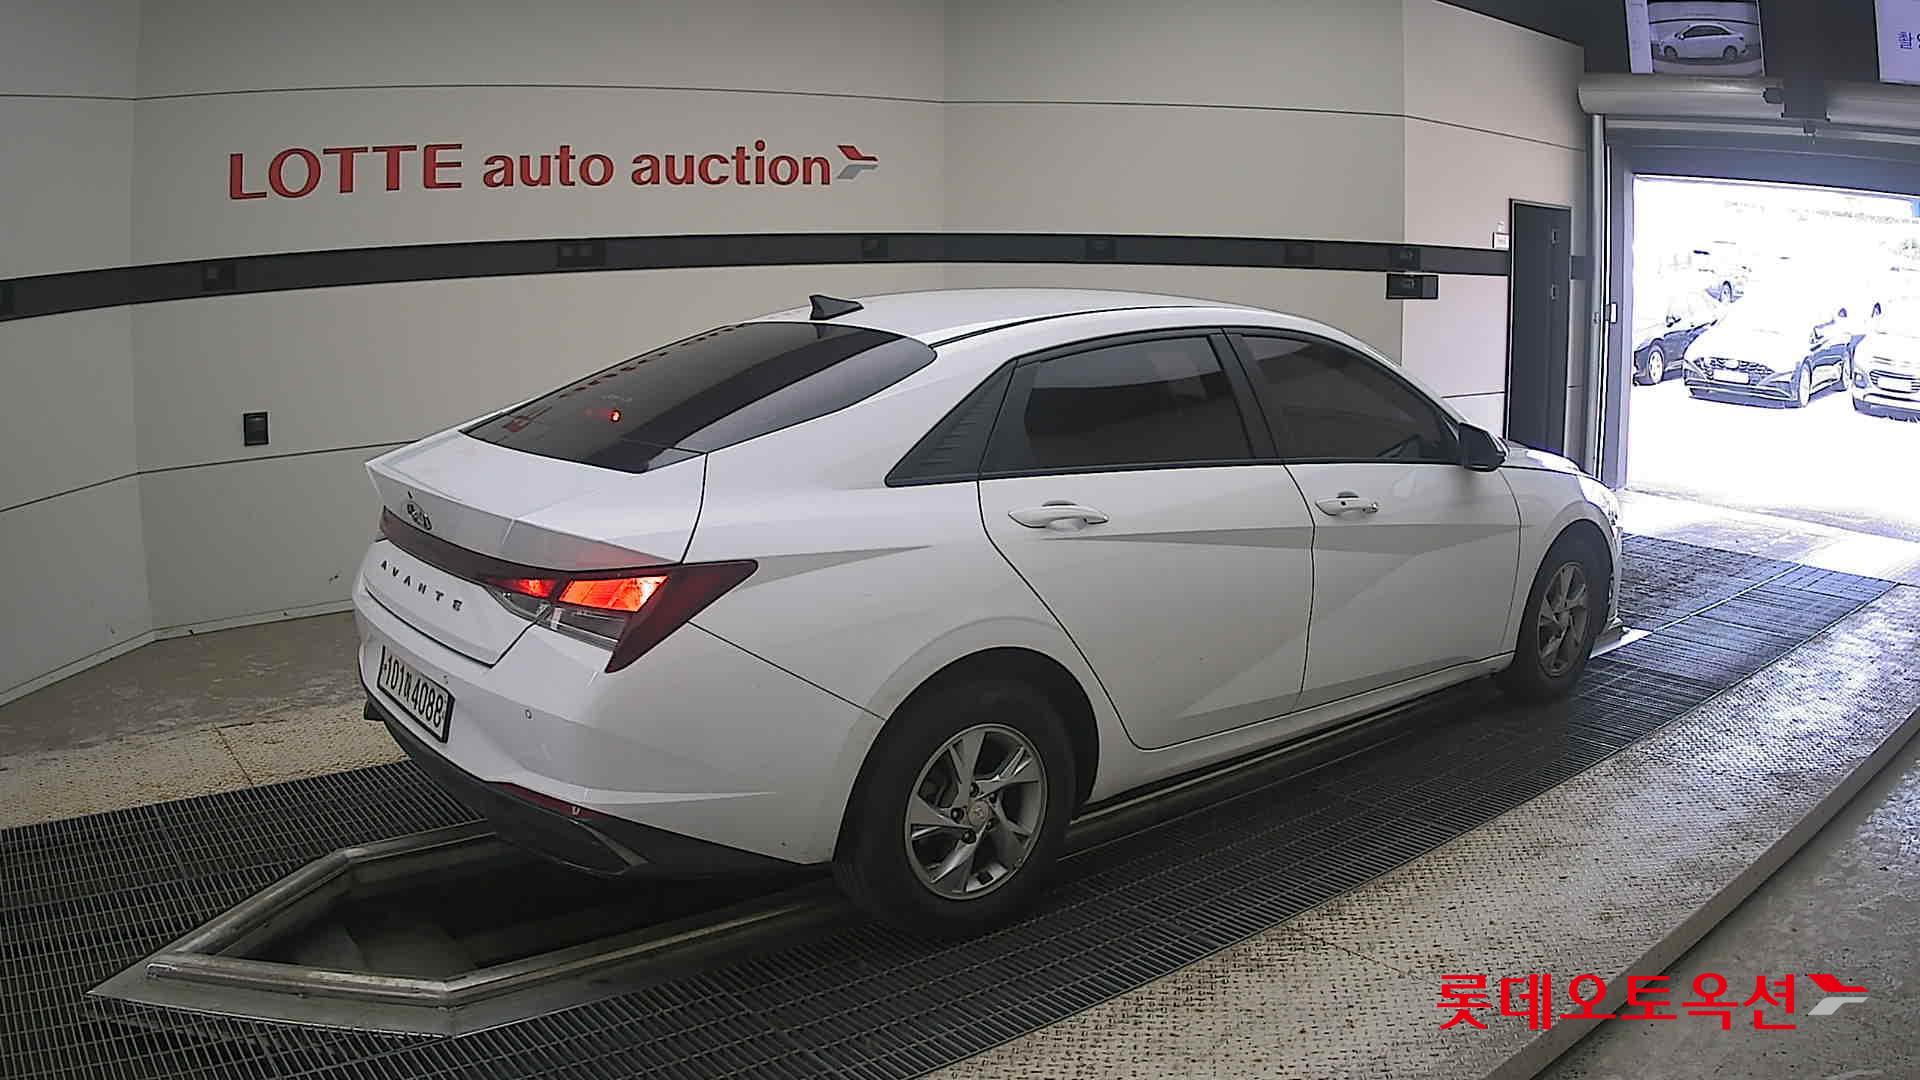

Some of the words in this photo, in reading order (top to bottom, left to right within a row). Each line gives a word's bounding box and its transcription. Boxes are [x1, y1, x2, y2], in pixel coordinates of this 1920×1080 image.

[228, 143, 463, 199] LOTTE
[482, 144, 615, 187] auto
[631, 139, 832, 186] auction
[380, 559, 464, 612] AVANTE
